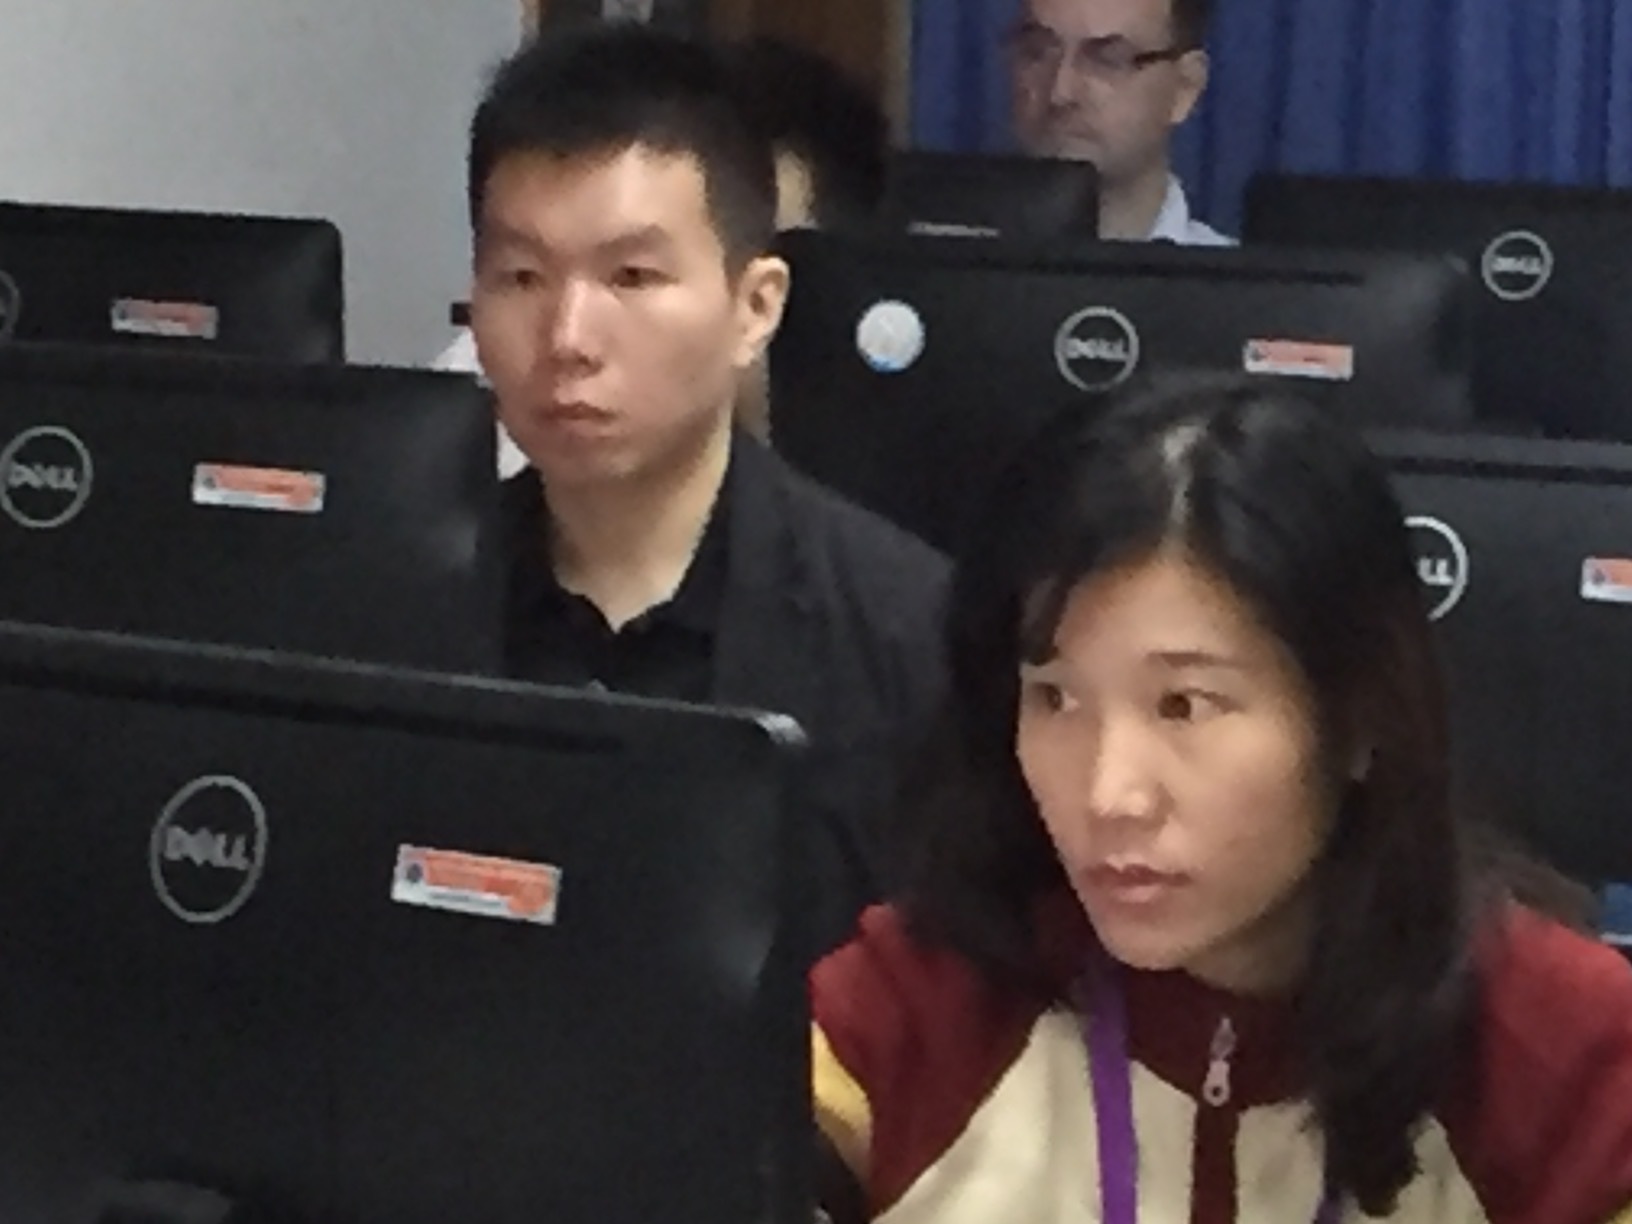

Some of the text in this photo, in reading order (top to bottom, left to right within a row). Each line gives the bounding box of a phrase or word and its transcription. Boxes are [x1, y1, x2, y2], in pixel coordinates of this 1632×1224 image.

[9, 461, 79, 492] DELL
[1418, 556, 1454, 586] LL
[165, 826, 252, 871] DELL
